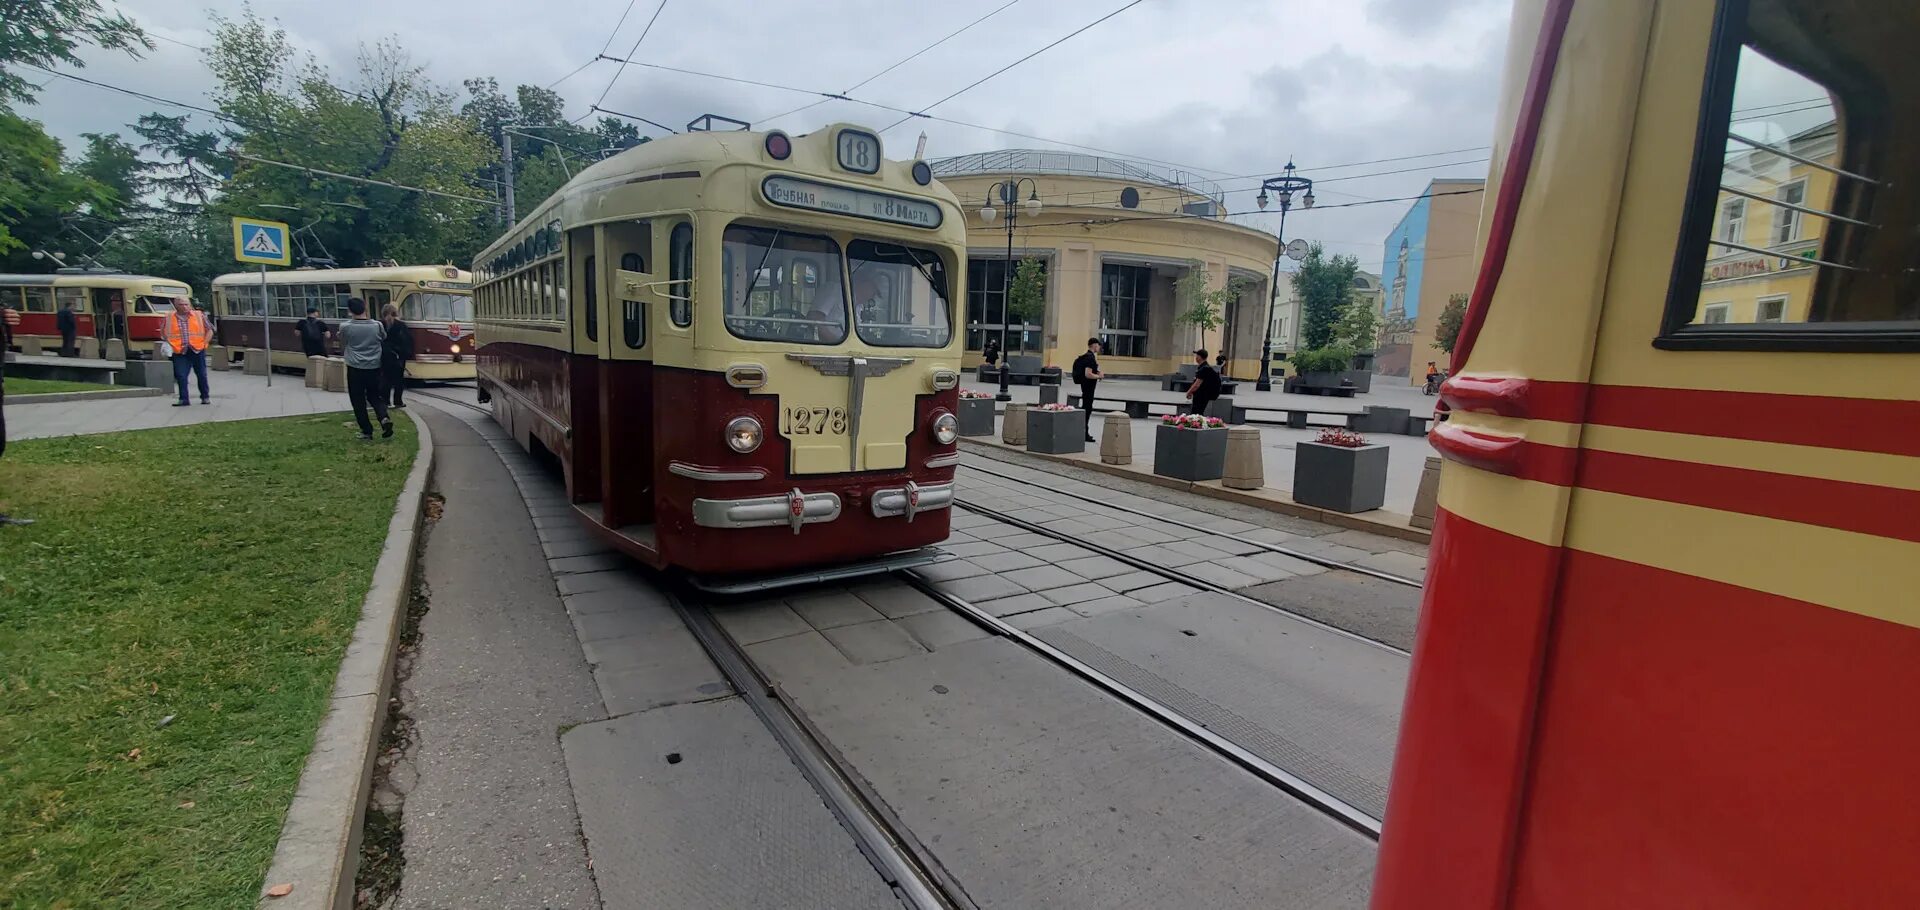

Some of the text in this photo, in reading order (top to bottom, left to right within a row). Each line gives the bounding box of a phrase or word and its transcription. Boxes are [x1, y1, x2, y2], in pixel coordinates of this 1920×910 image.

[846, 137, 869, 167] 18
[769, 183, 815, 205] ТРУБНАЯ
[885, 200, 894, 217] 8
[896, 204, 929, 223] МАРТА
[784, 407, 847, 435] 1278
